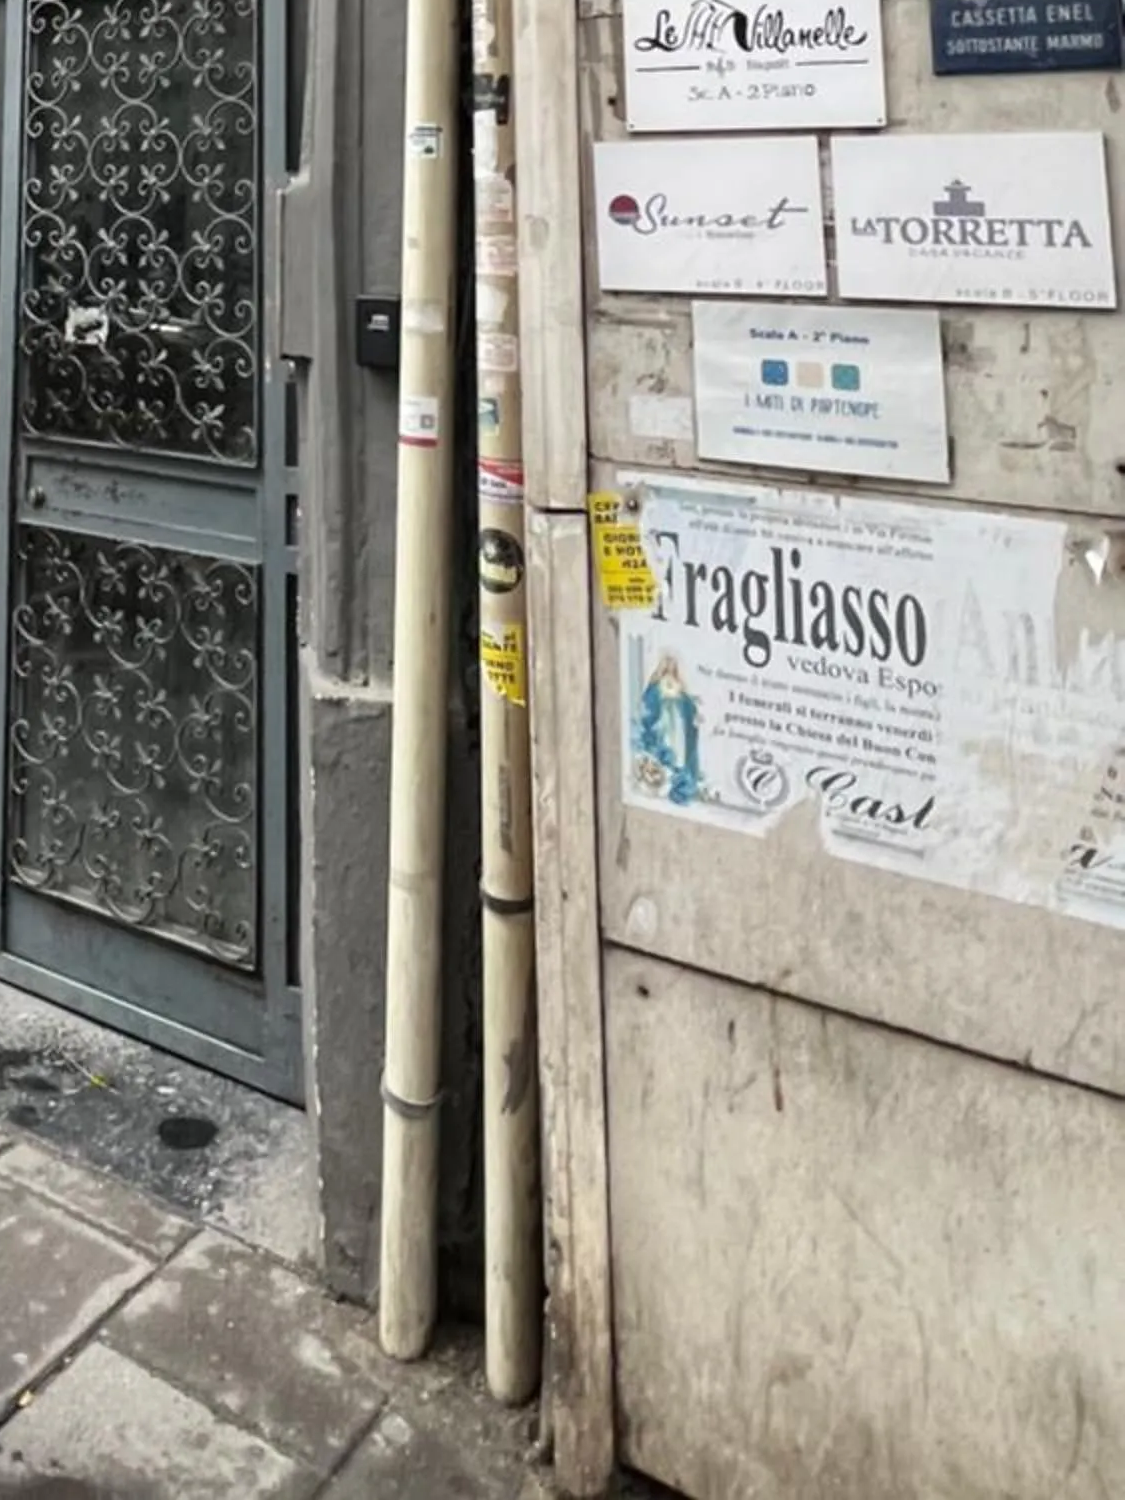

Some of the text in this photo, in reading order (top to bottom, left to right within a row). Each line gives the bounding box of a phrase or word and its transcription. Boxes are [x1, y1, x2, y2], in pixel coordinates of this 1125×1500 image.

[725, 3, 868, 54] Villanelle
[950, 3, 1094, 29] CASSETTA ENEL
[946, 32, 1104, 57] SOTTOSTANTE MARMO
[633, 192, 809, 236] Sunset
[850, 216, 1093, 248] LA TORRETTA
[749, 328, 784, 340] Scala
[787, 329, 798, 340] A
[830, 332, 870, 345] Piano
[786, 655, 870, 685] vedova
[738, 692, 792, 714] funerali
[810, 708, 873, 731] terranno
[785, 723, 833, 742] Chiesa
